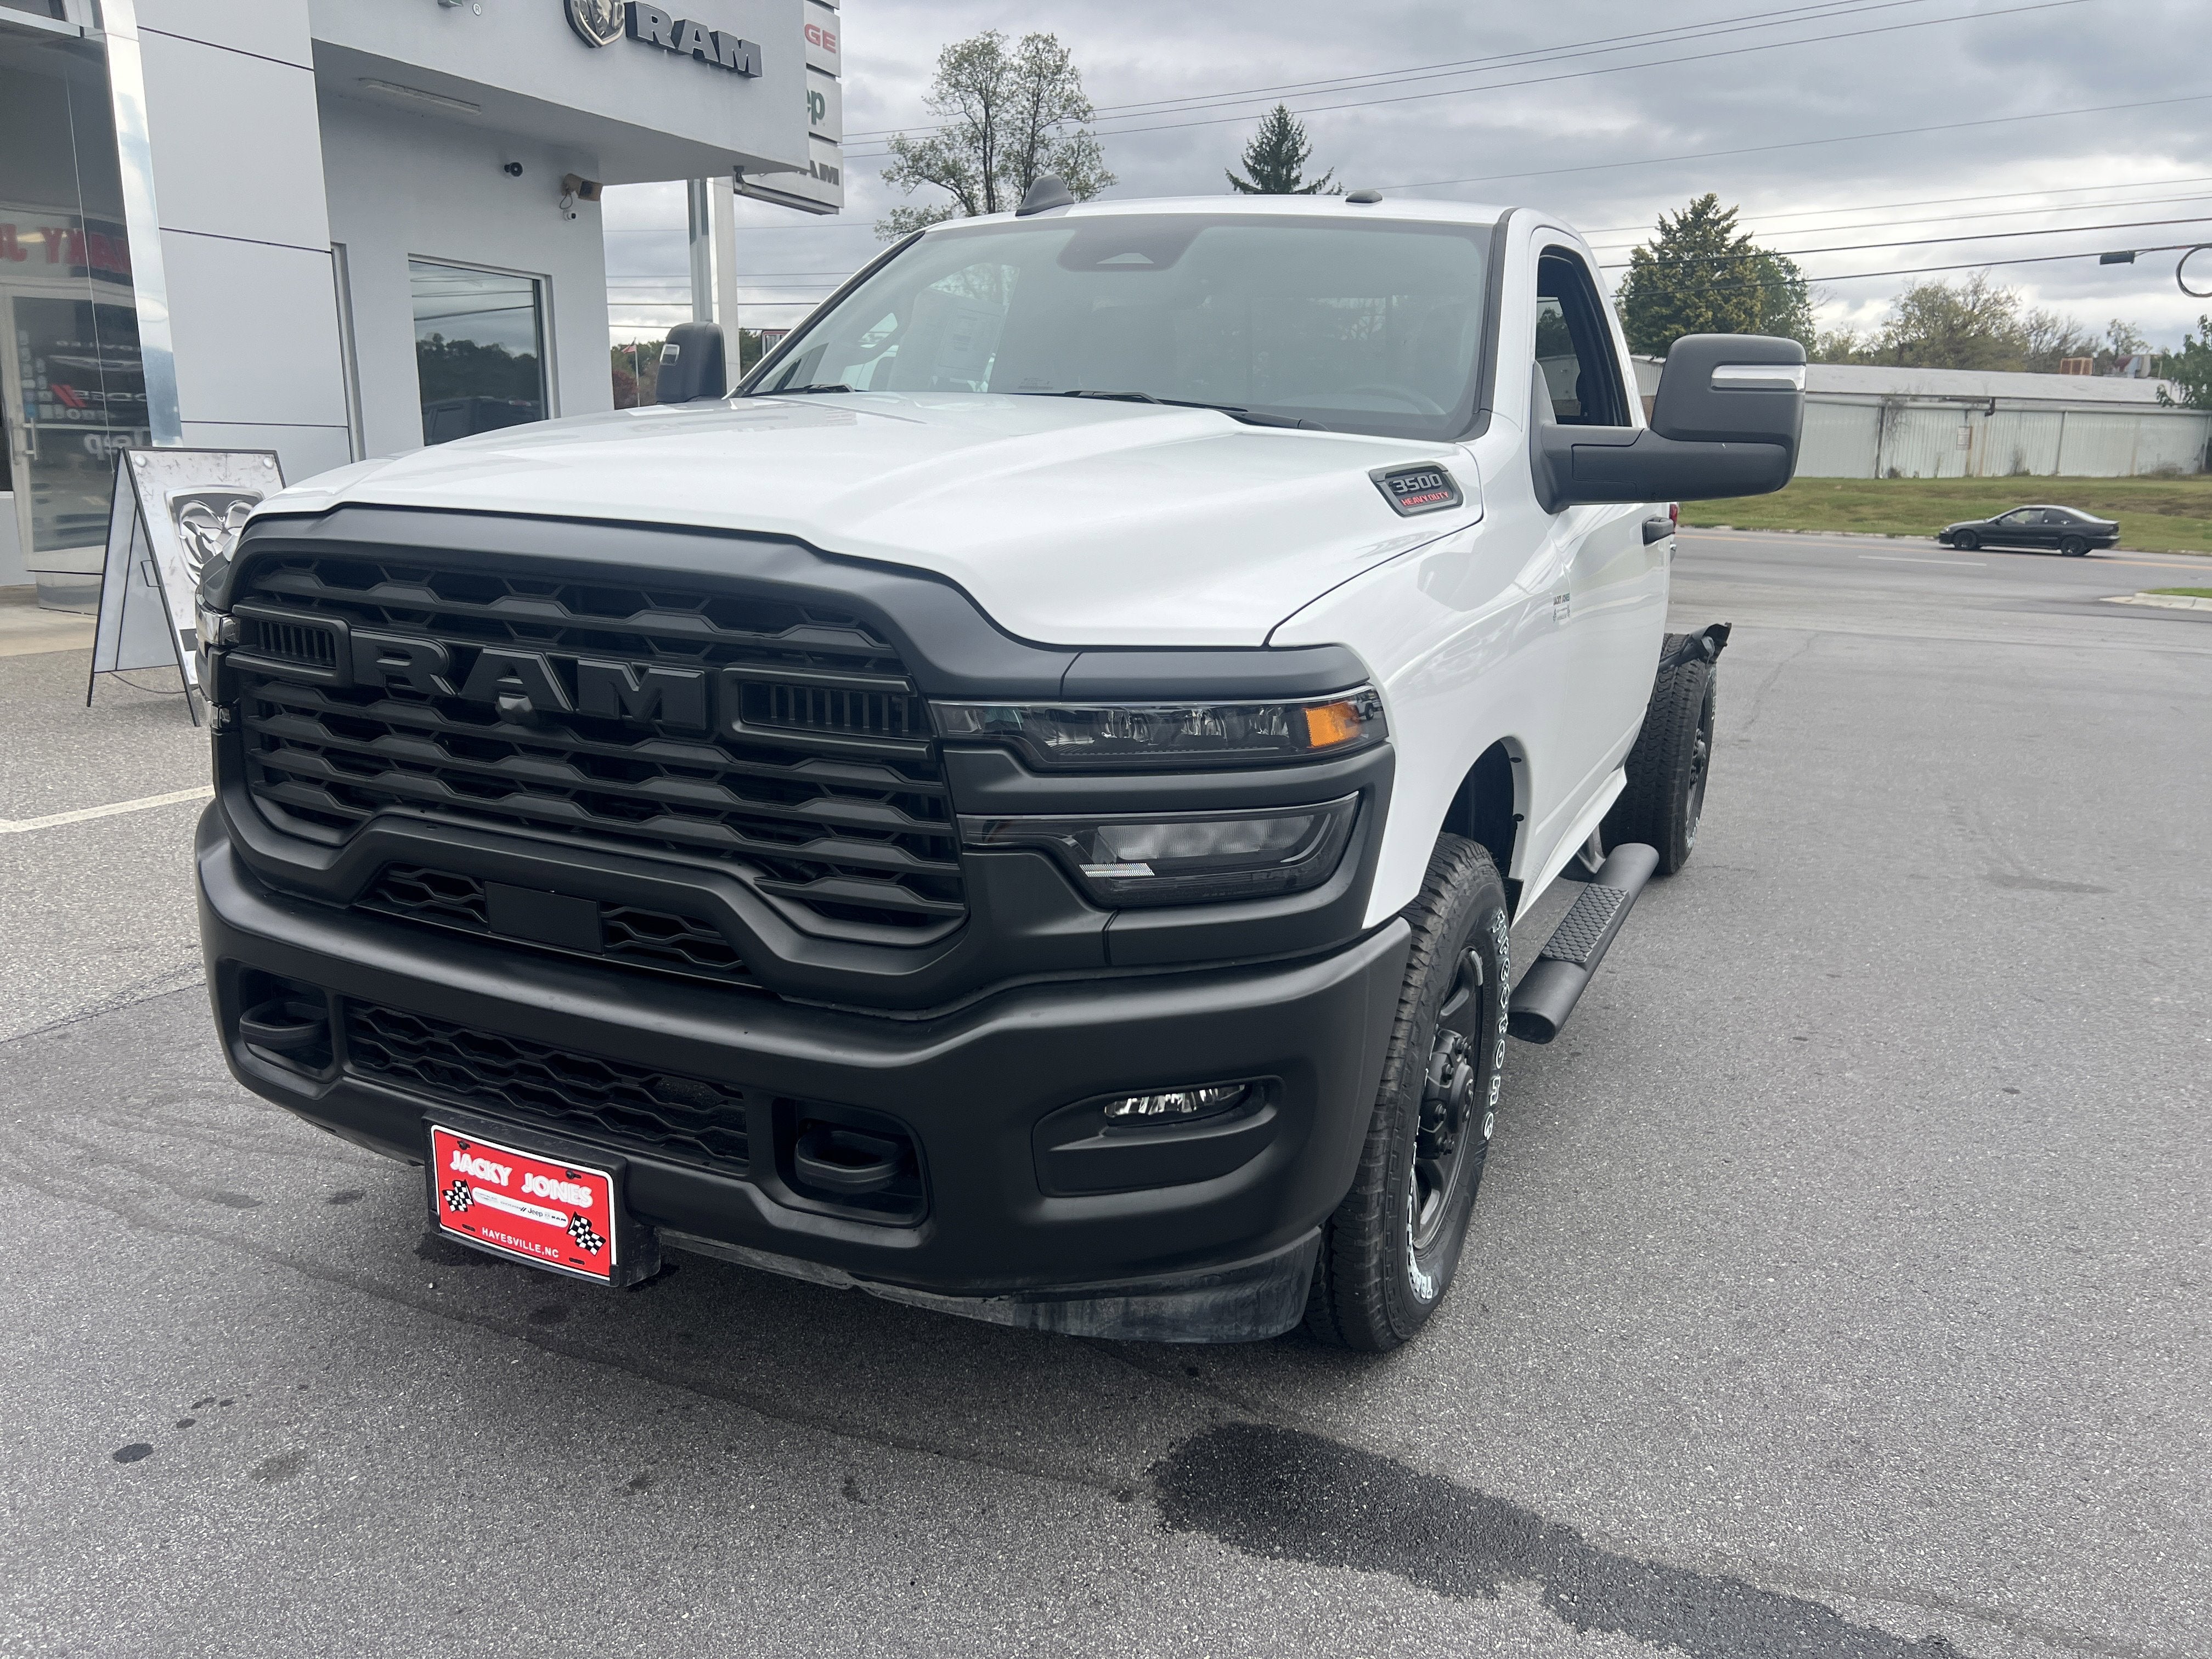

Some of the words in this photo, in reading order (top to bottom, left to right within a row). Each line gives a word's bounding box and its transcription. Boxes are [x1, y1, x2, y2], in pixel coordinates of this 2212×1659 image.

[625, 1, 762, 78] RAM
[807, 90, 825, 125] p
[1392, 474, 1443, 494] 3500
[1401, 496, 1427, 506] HEAVY
[1427, 492, 1448, 501] DUTY
[351, 630, 706, 730] RAM
[450, 1150, 512, 1186] JACKY
[522, 1173, 593, 1207] JONES
[528, 1207, 543, 1217] Jeep
[482, 1227, 560, 1259] HAYESVILLE,NC
